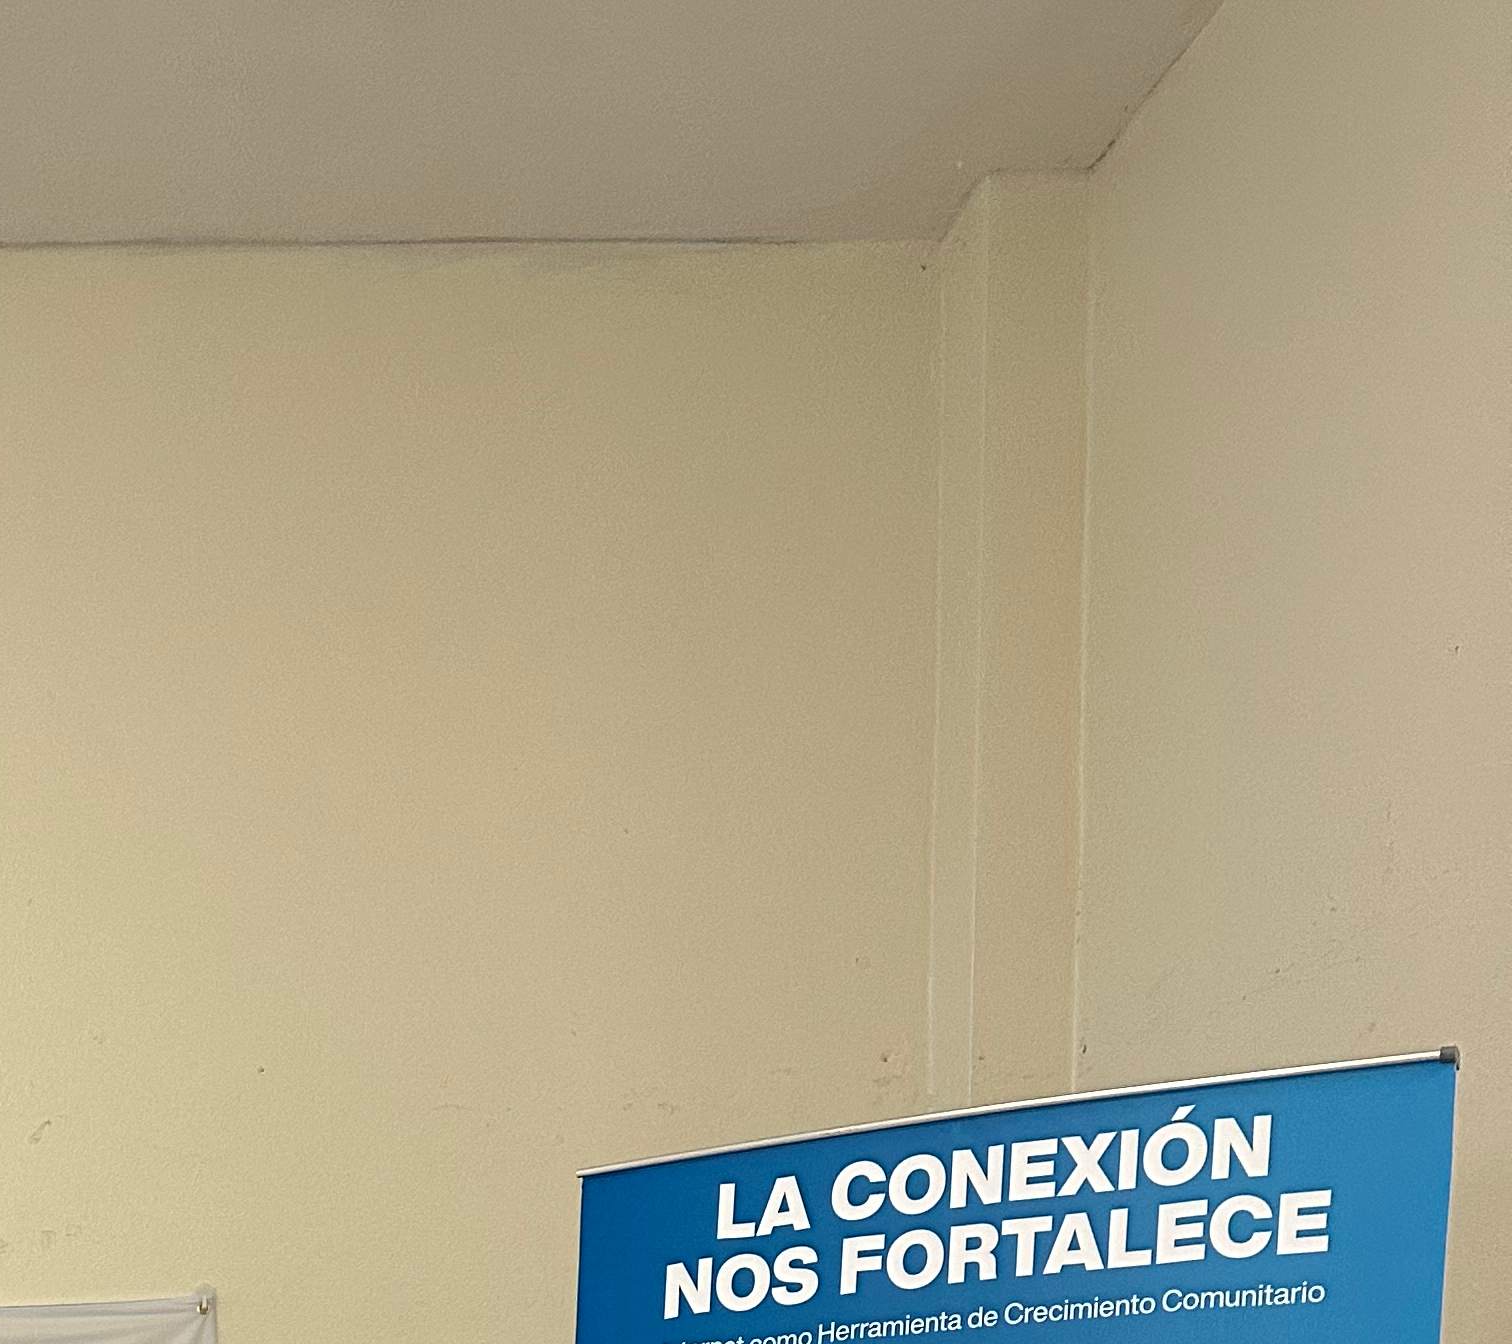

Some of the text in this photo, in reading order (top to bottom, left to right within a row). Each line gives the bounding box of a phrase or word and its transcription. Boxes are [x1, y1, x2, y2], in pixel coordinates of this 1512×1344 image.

[716, 1104, 1272, 1239] LA CONEXIÓN
[663, 1189, 1332, 1320] NOS FORTALECE
[817, 1311, 963, 1344] Herramienta
[967, 1307, 998, 1329] de
[1004, 1295, 1156, 1325] Crecimiento
[1161, 1281, 1326, 1312] Comunitario
